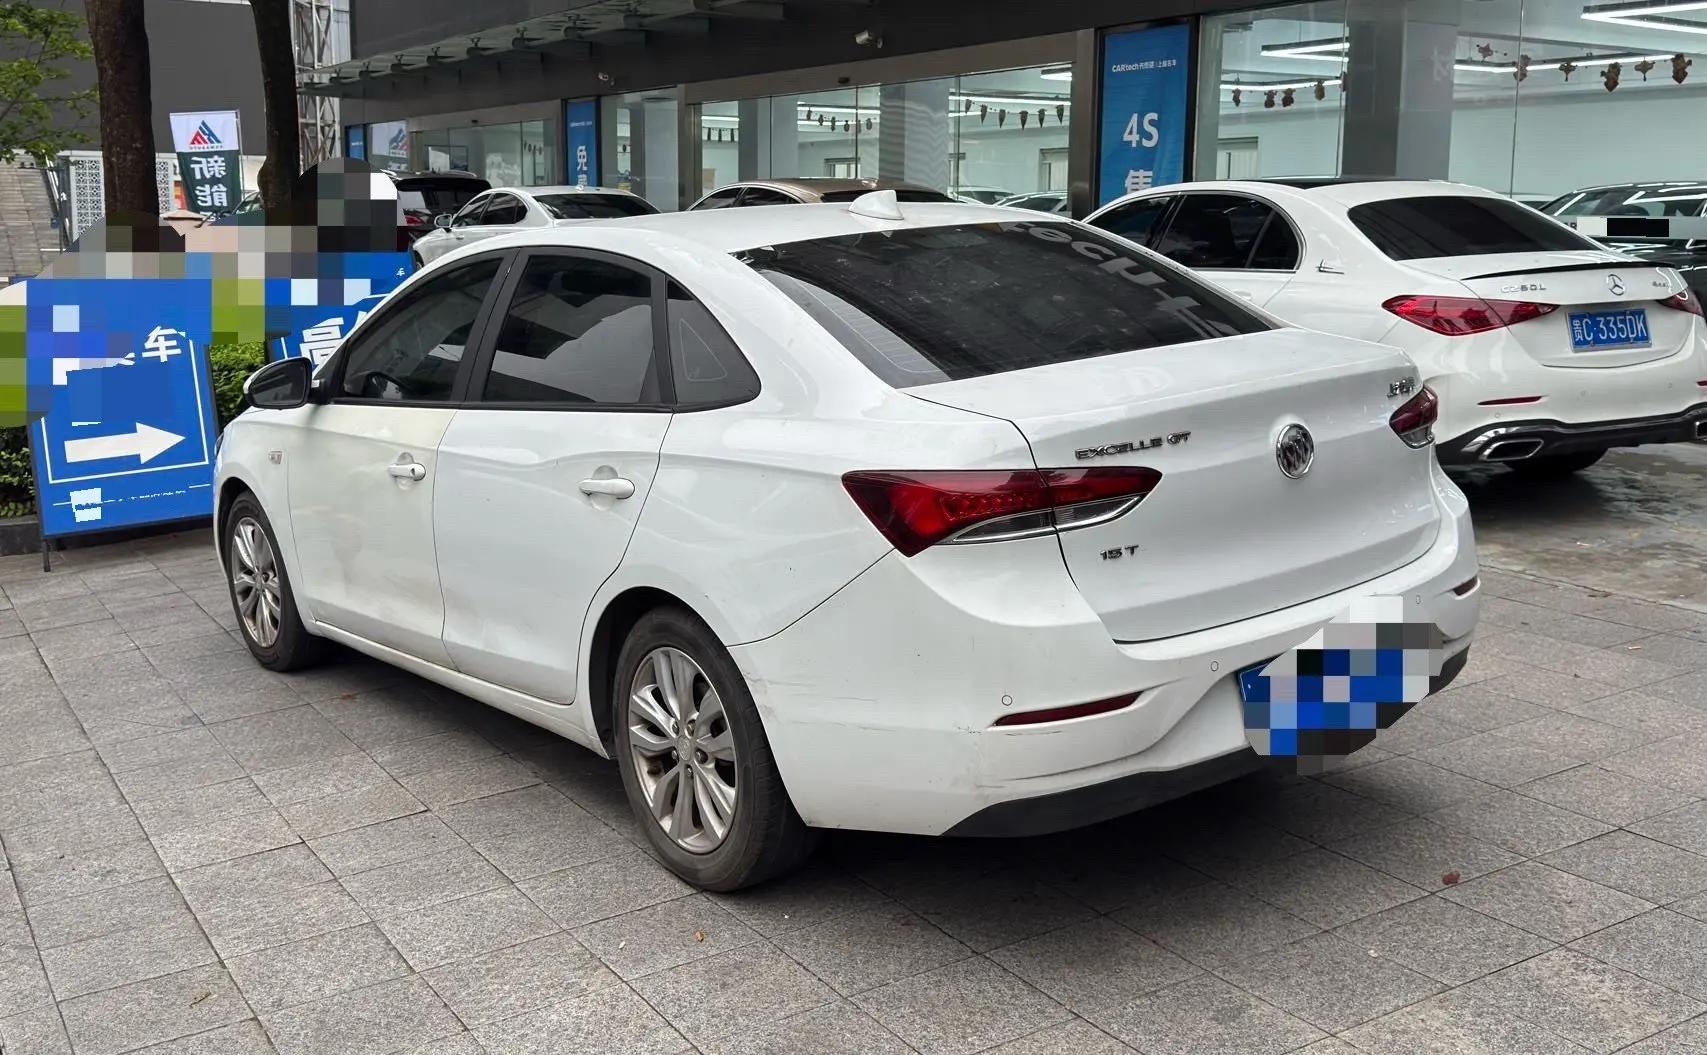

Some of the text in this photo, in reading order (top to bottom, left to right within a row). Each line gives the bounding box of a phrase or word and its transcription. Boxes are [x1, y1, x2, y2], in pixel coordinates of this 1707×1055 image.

[1123, 112, 1159, 148] 4S
[1075, 431, 1191, 460] EXCELLE GT
